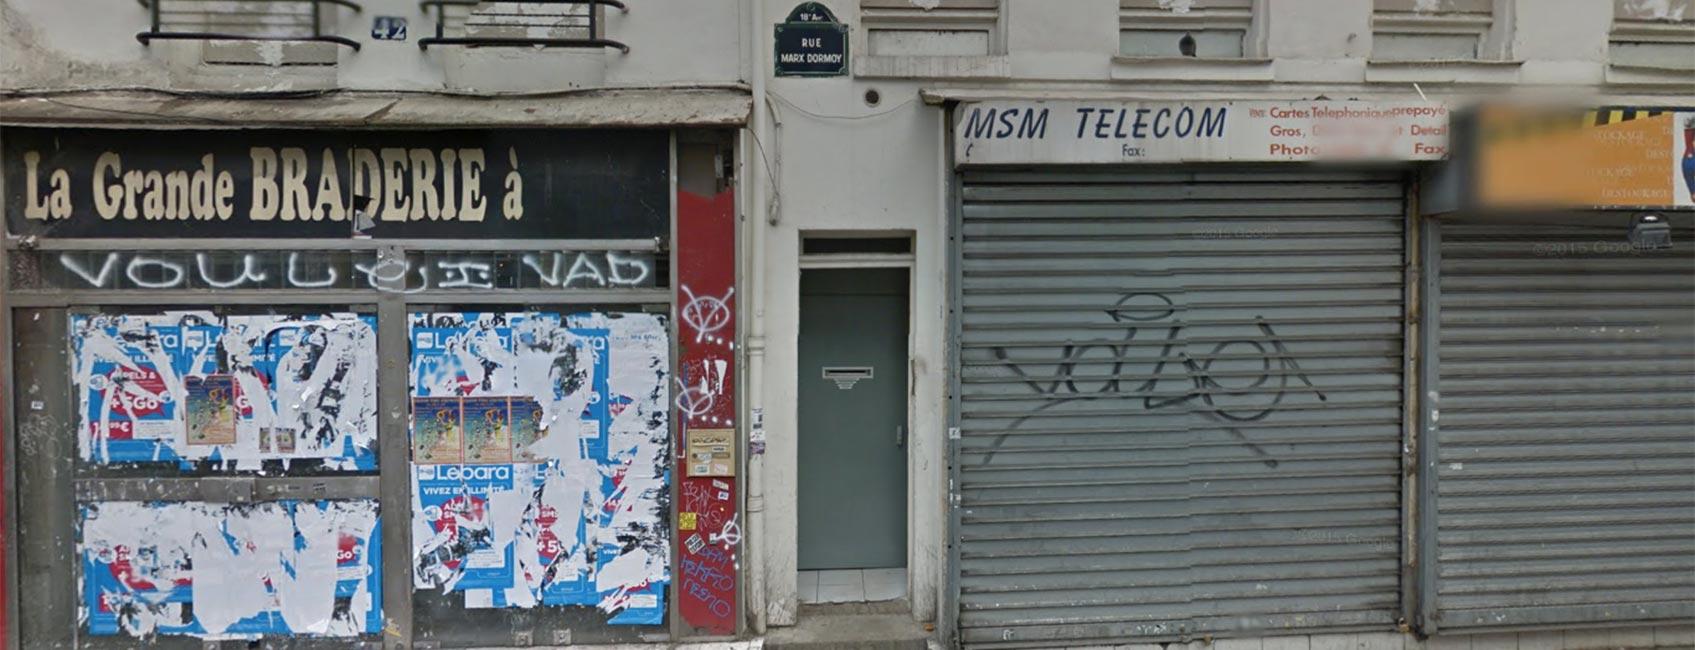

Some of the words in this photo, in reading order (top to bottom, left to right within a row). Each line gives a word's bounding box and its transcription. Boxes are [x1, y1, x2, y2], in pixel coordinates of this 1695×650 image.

[374, 18, 404, 38] 42
[801, 38, 822, 48] RUE
[781, 53, 805, 63] MARX
[807, 53, 842, 63] DORMOY
[1269, 106, 1310, 119] Cartes
[964, 107, 1050, 140] MSM
[1076, 106, 1228, 139] TELECOM
[1121, 144, 1146, 158] Fax:
[1414, 143, 1446, 155] Fax
[23, 151, 73, 222] La
[92, 151, 235, 222] Grande
[249, 147, 487, 224] BRADERIE
[502, 145, 525, 222] à
[437, 464, 510, 480] Lebara
[423, 486, 451, 496] VIVEZ
